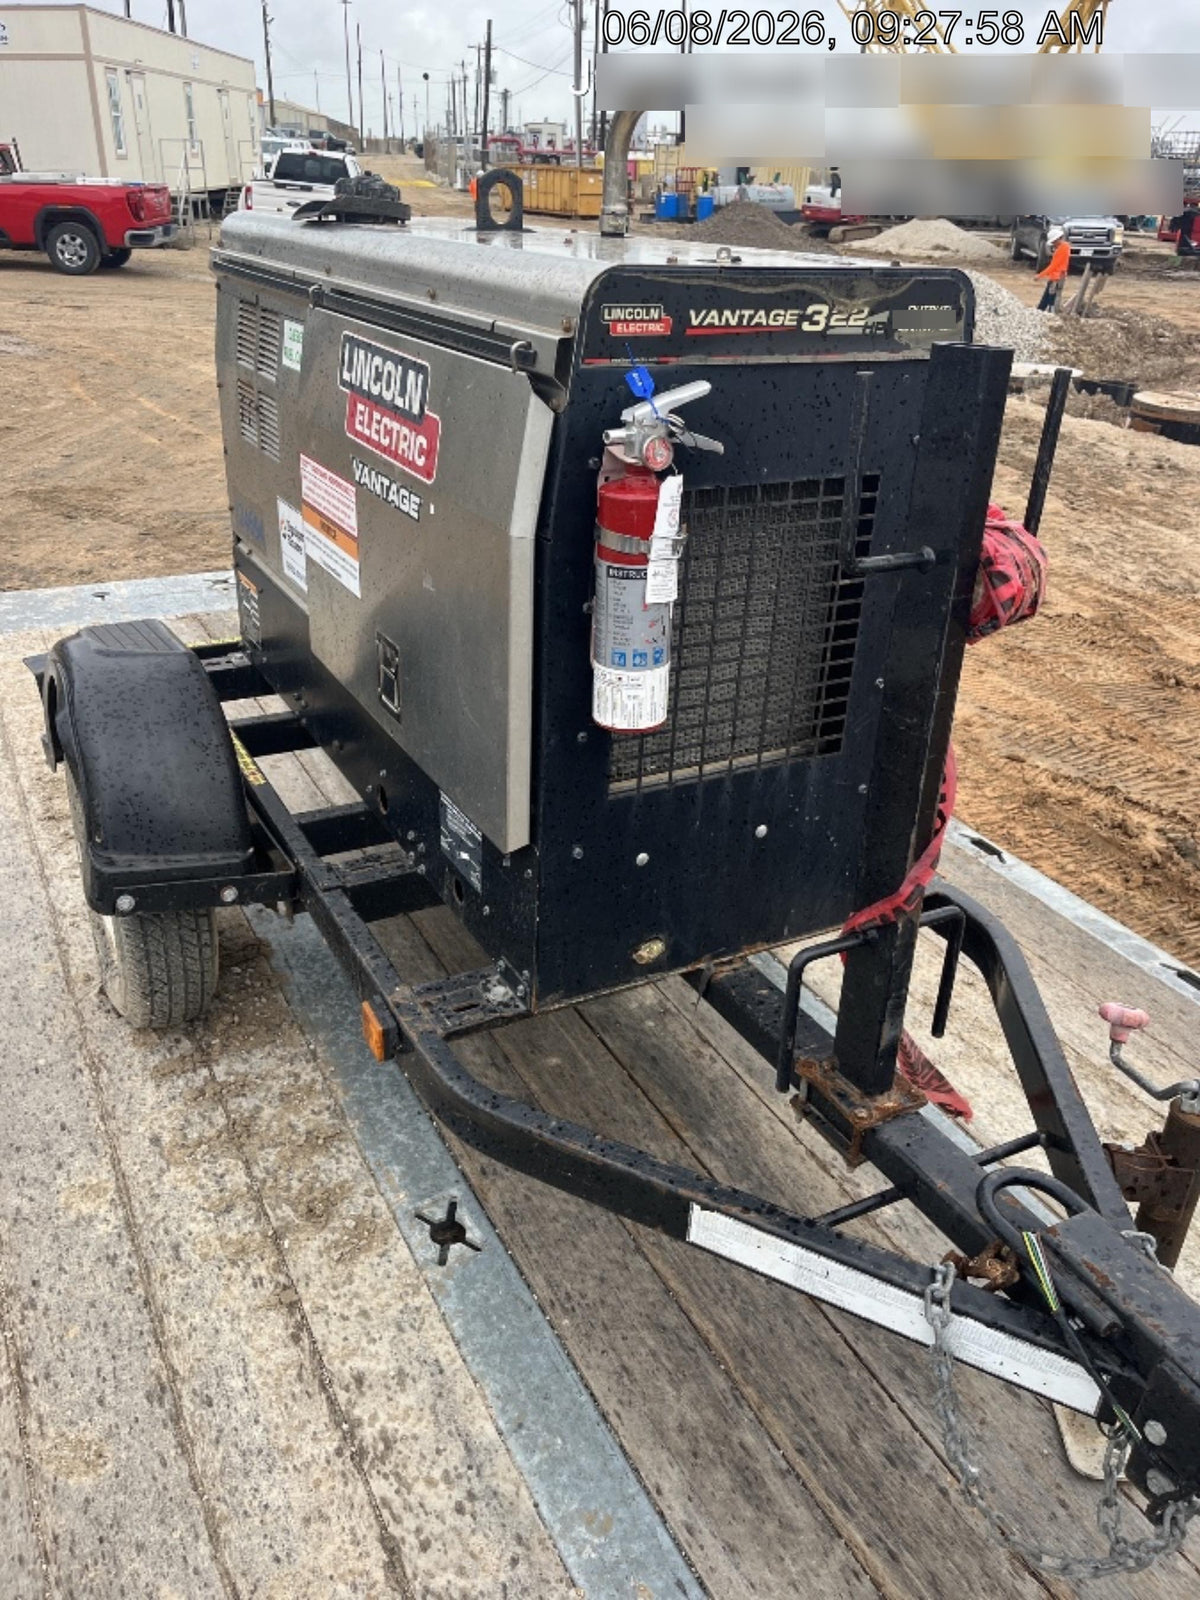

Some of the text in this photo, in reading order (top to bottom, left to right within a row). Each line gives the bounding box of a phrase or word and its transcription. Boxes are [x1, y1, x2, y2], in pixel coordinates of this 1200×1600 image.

[603, 306, 660, 321] LINCOLN
[616, 322, 666, 333] ELECTRIC
[689, 308, 801, 327] VANTAGE
[342, 343, 424, 416] LINCOLN
[354, 402, 428, 467] ELECTRIC
[351, 456, 421, 522] VANTAGE
